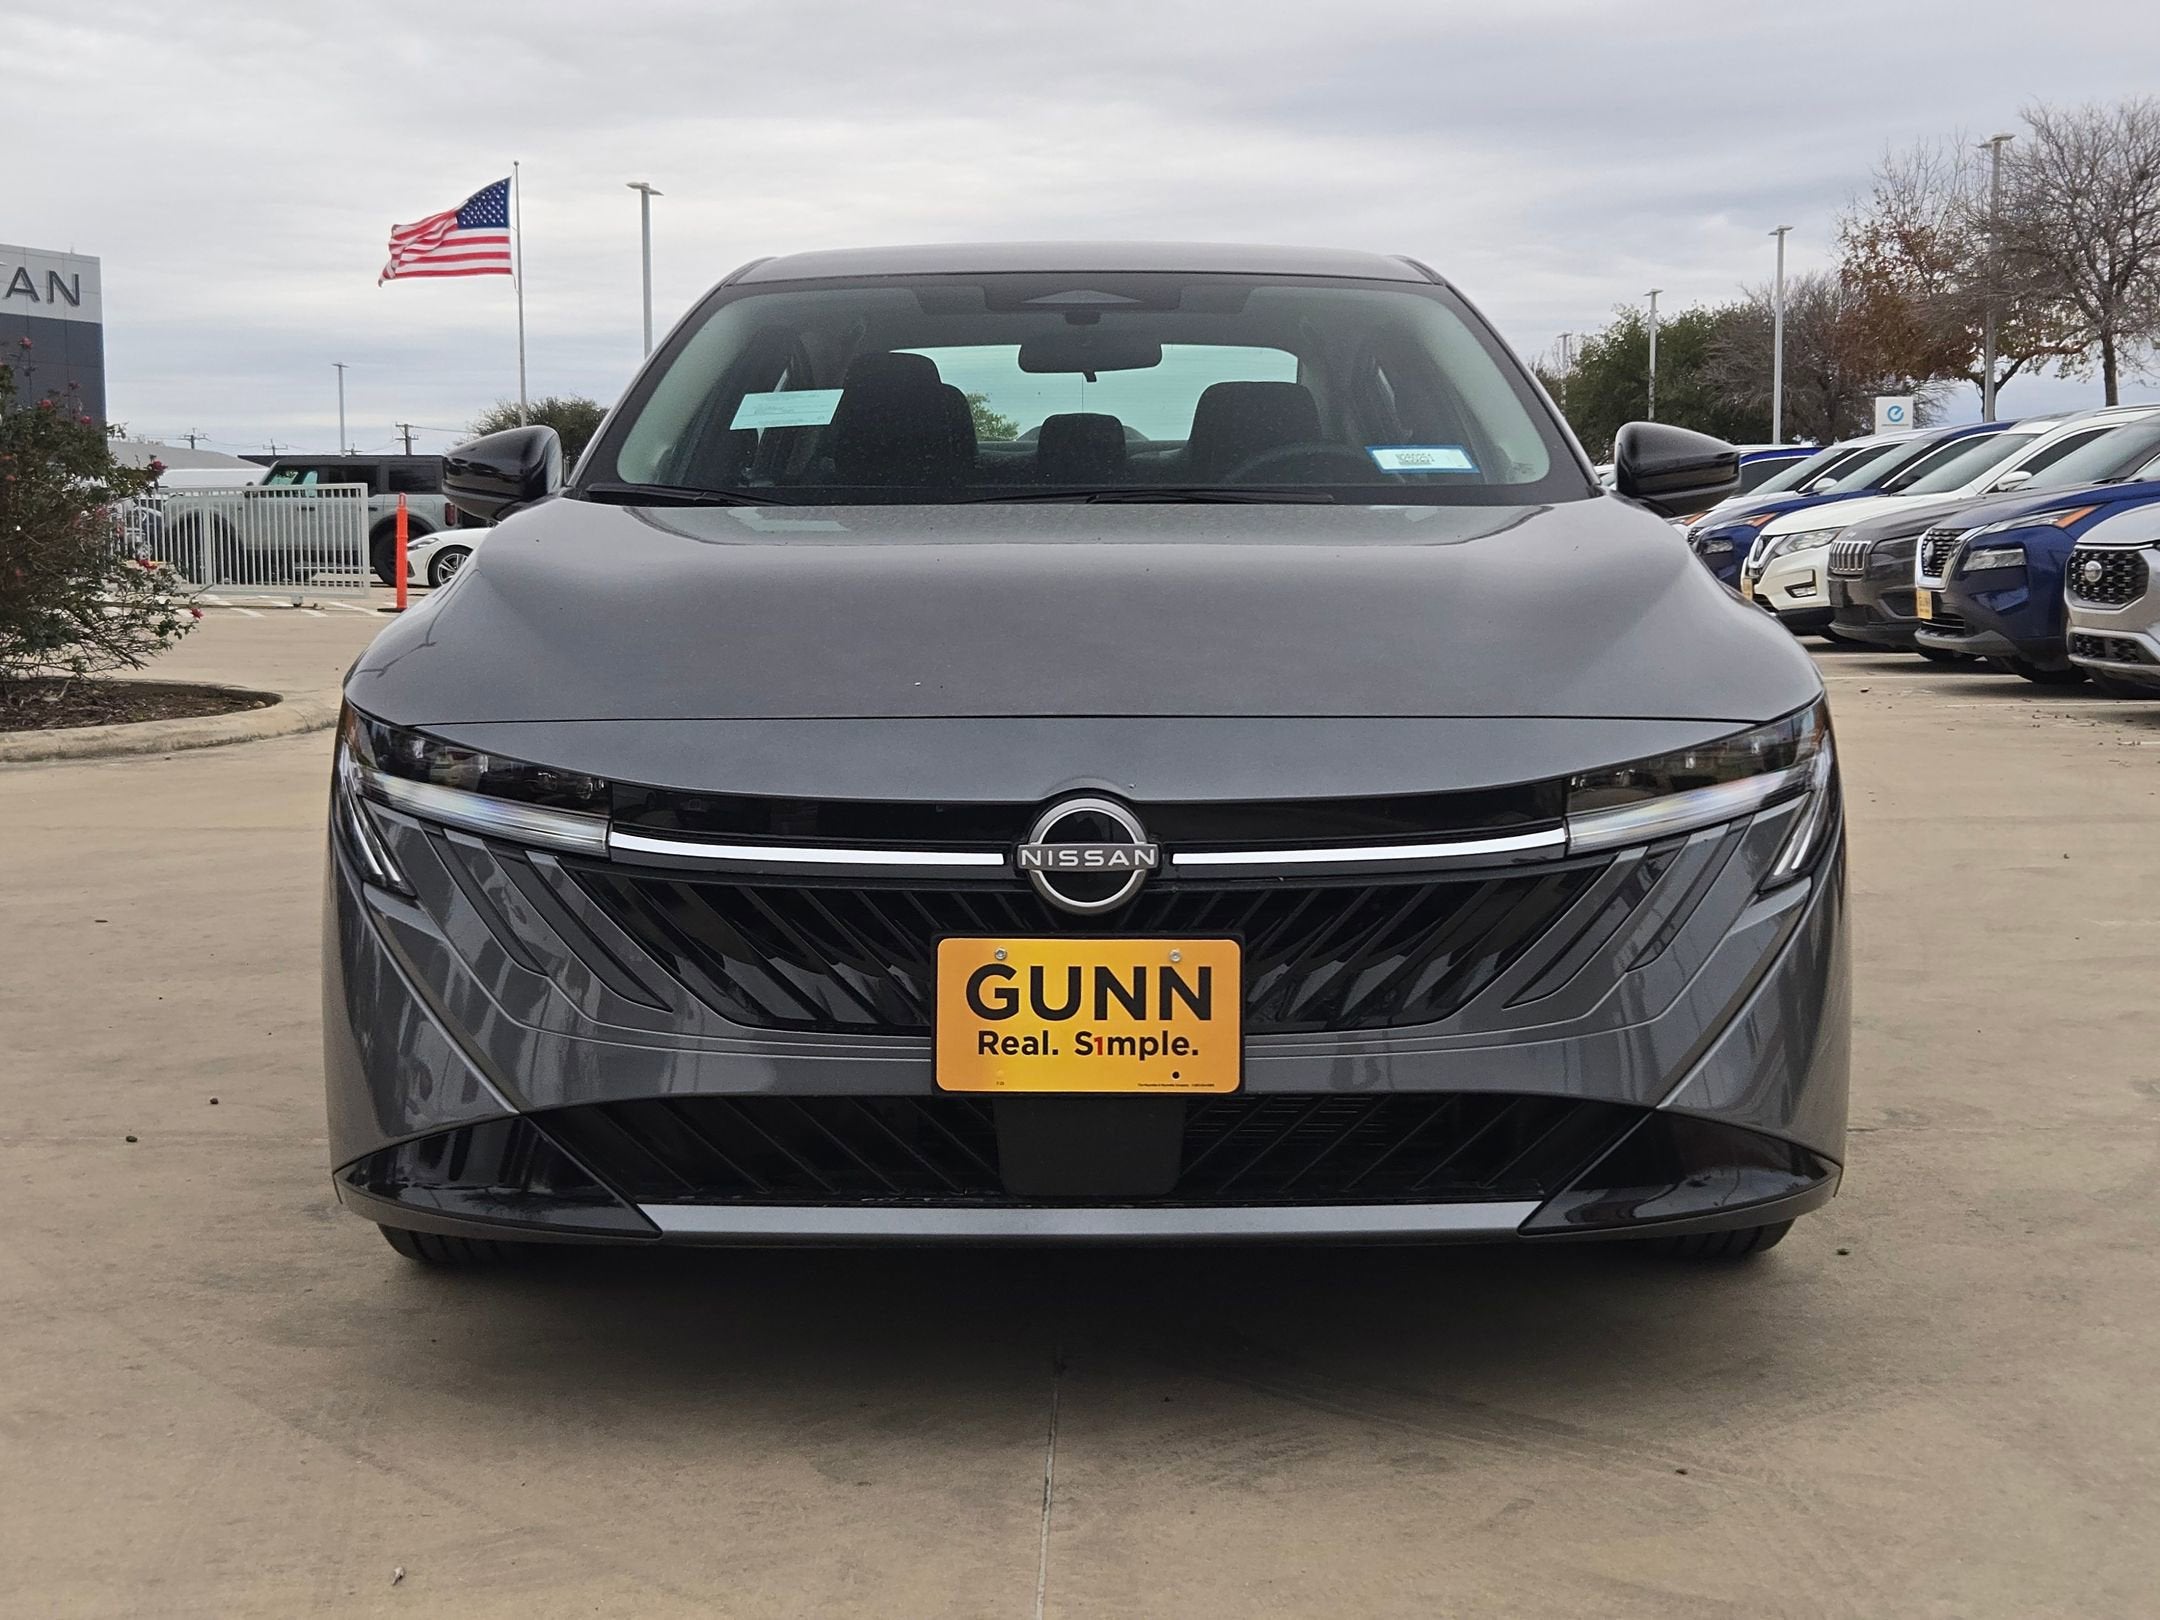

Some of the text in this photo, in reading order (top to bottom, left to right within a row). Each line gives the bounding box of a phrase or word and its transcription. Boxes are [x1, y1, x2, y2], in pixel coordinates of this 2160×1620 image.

[1021, 849, 1155, 867] NISSAN
[966, 963, 1212, 1021] GUNN
[978, 1030, 1199, 1061] Real. S1mple.
